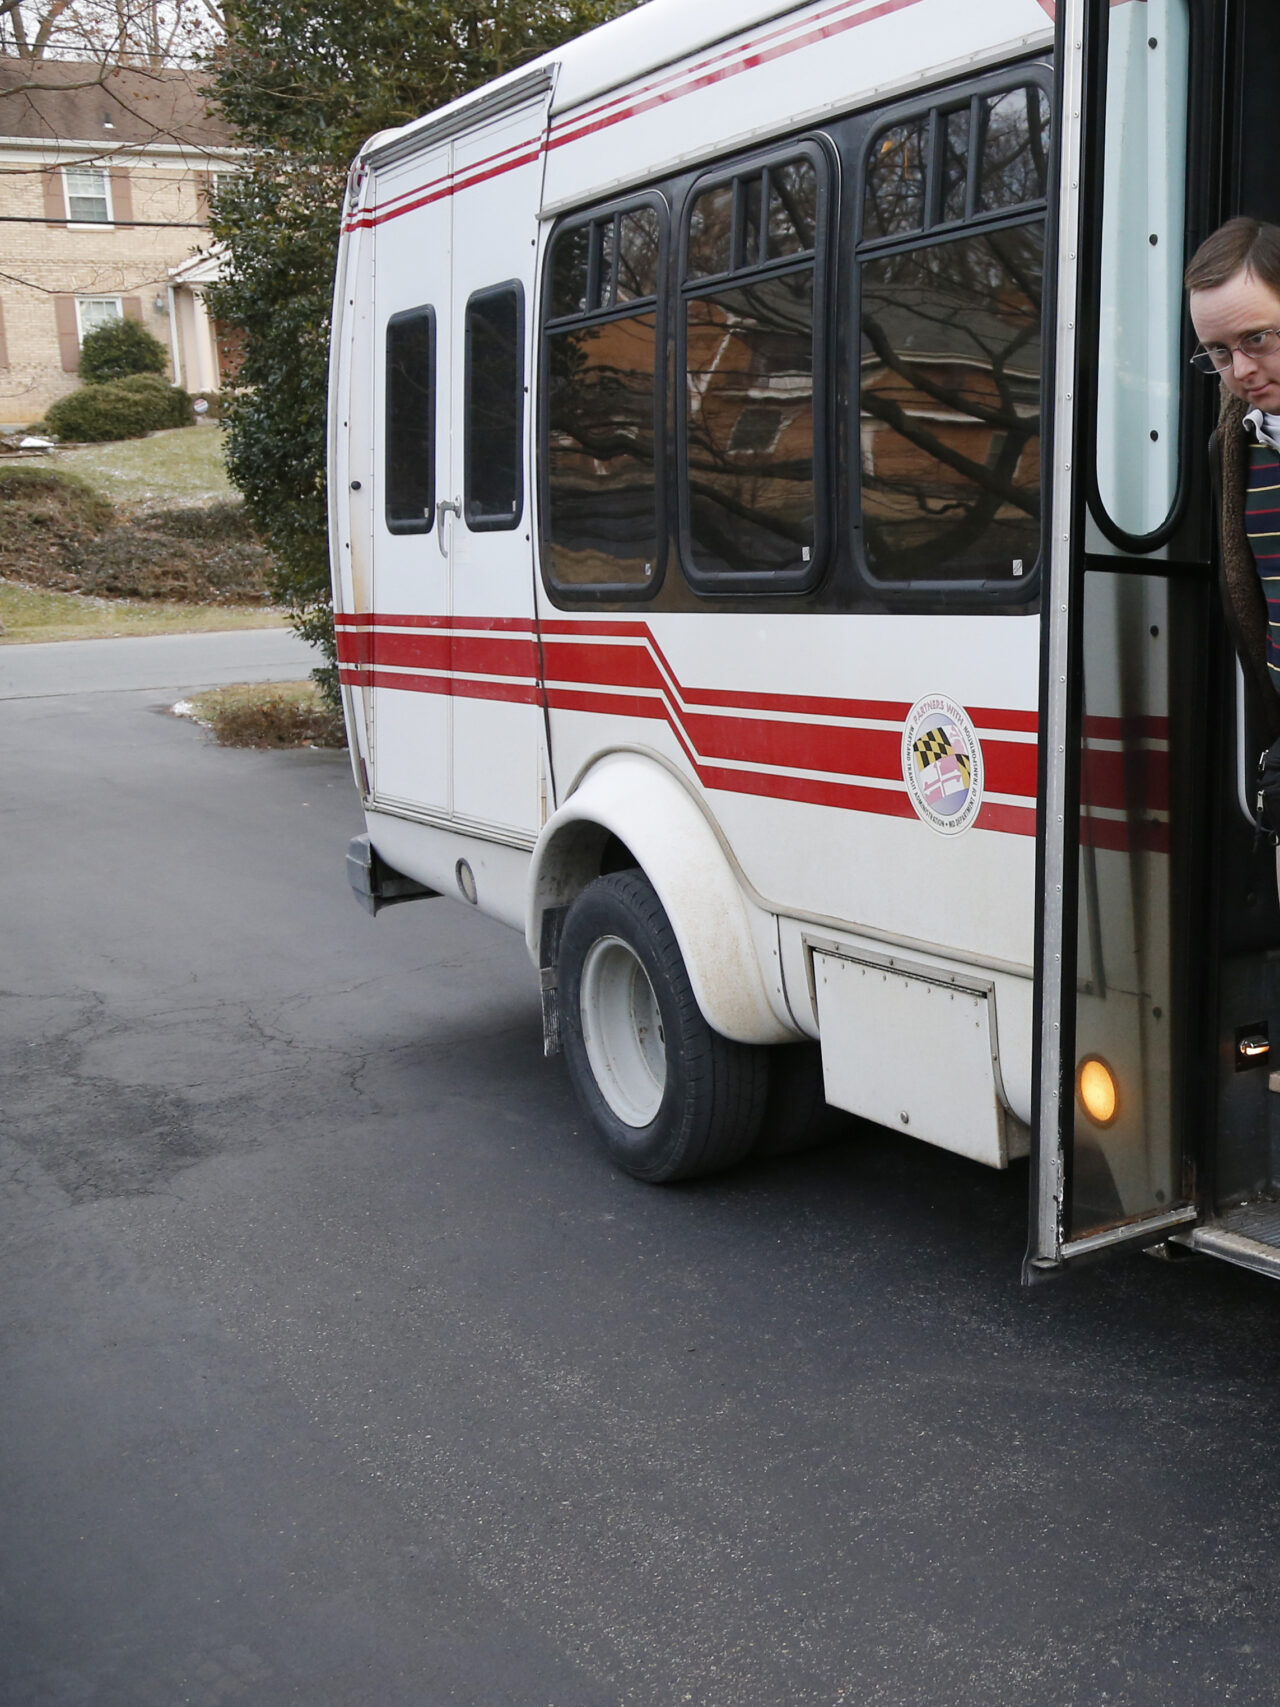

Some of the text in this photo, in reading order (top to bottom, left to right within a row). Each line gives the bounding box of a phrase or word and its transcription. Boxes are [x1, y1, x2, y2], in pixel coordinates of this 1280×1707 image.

[913, 700, 964, 725] PARTNERS WITH
[906, 725, 915, 761] MARYLAND
[963, 726, 979, 786] TRANSPORTATION
[907, 763, 916, 790] TRANSIT
[955, 797, 975, 826] DEPARTMENT
